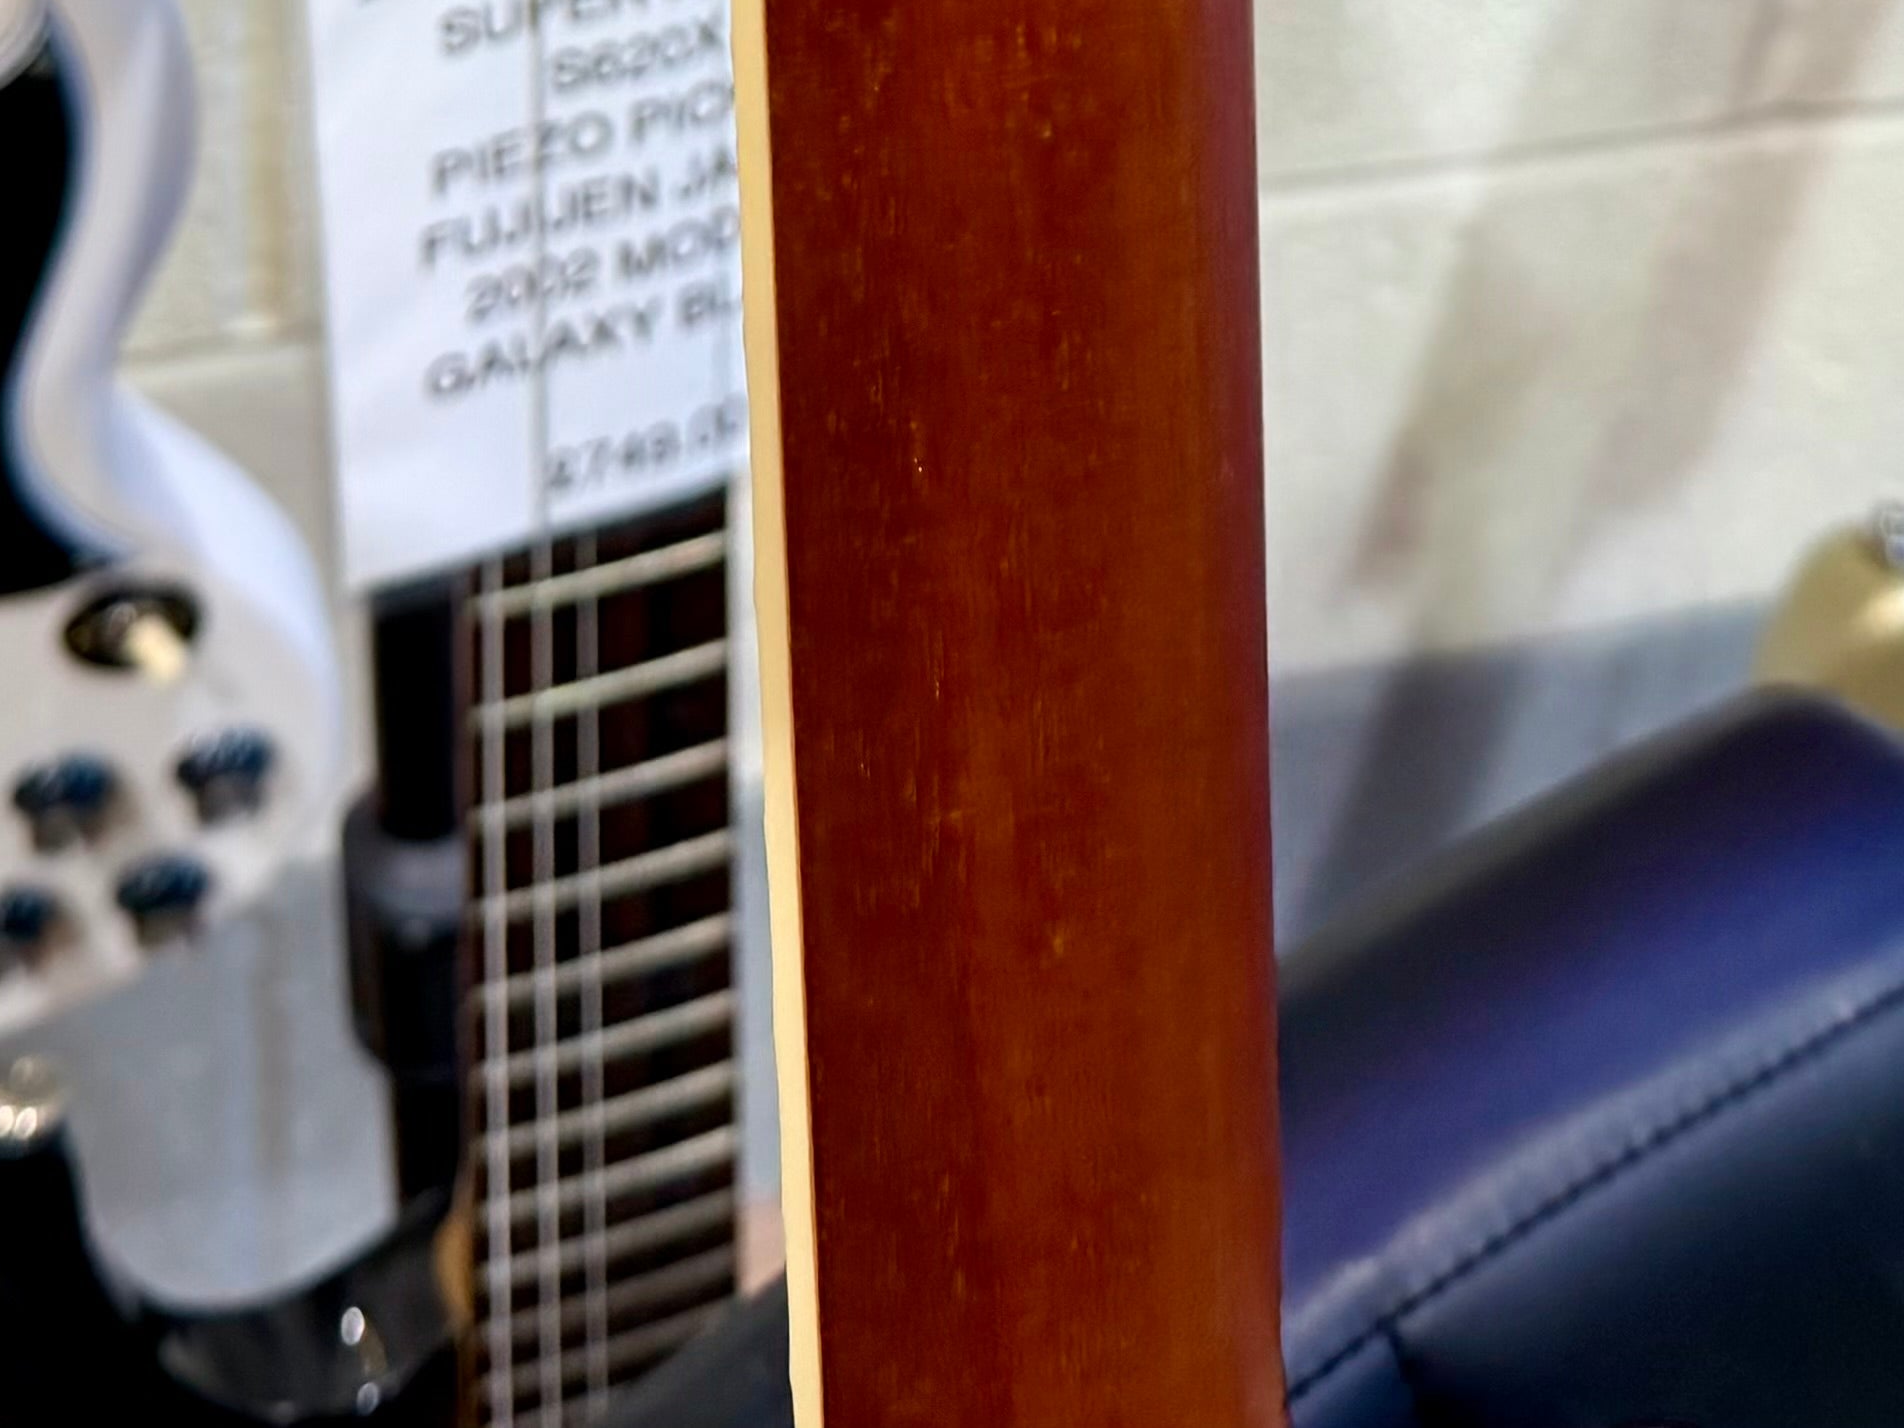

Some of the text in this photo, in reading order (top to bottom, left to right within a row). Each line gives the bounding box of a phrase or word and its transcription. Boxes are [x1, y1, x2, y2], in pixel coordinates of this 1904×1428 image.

[430, 81, 735, 194] PIEZO PIC
[616, 204, 740, 277] MOD
[422, 294, 664, 404] GALAXY
